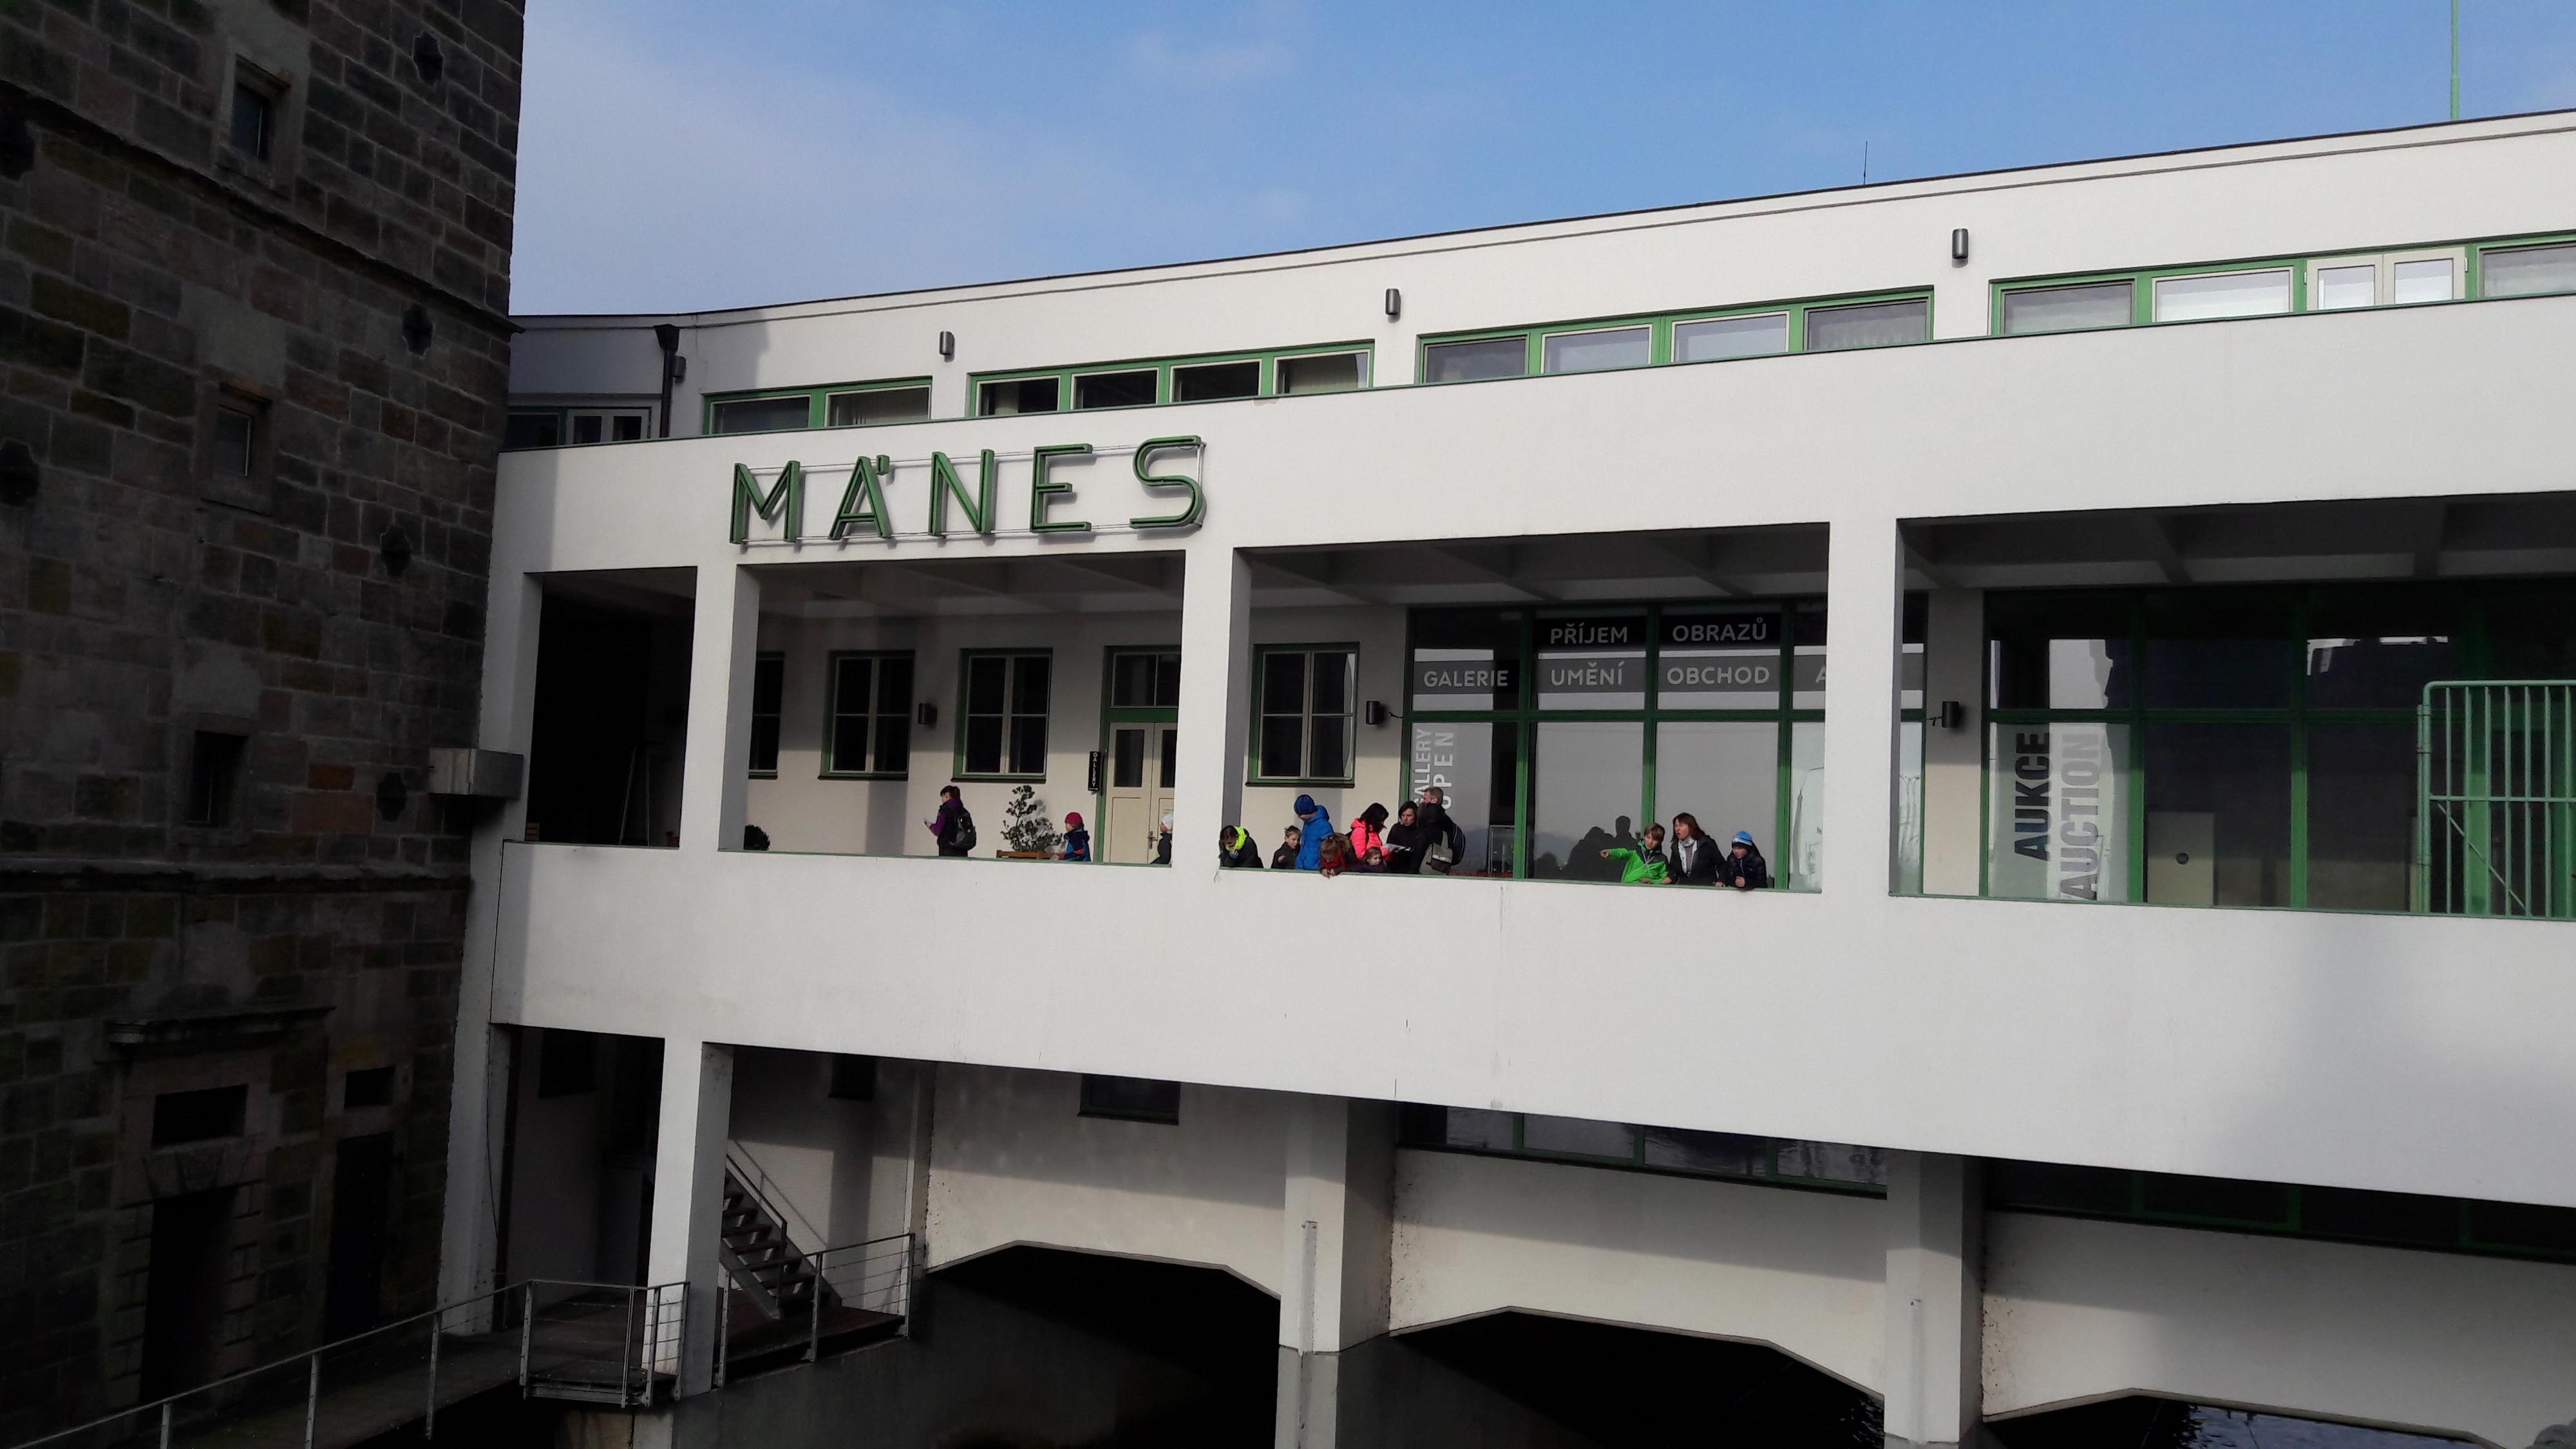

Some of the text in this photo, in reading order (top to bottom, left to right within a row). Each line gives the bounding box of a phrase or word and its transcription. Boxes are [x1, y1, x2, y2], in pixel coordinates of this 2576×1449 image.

[729, 435, 1202, 544] MÁNES
[1423, 661, 1770, 688] GALERIE UMĚNÍ OBCHOD
[1550, 617, 1767, 644] PŘÍJEM OBRAZŮ
[2014, 732, 2050, 862] AUKCE
[2060, 734, 2099, 900] AUCTION
